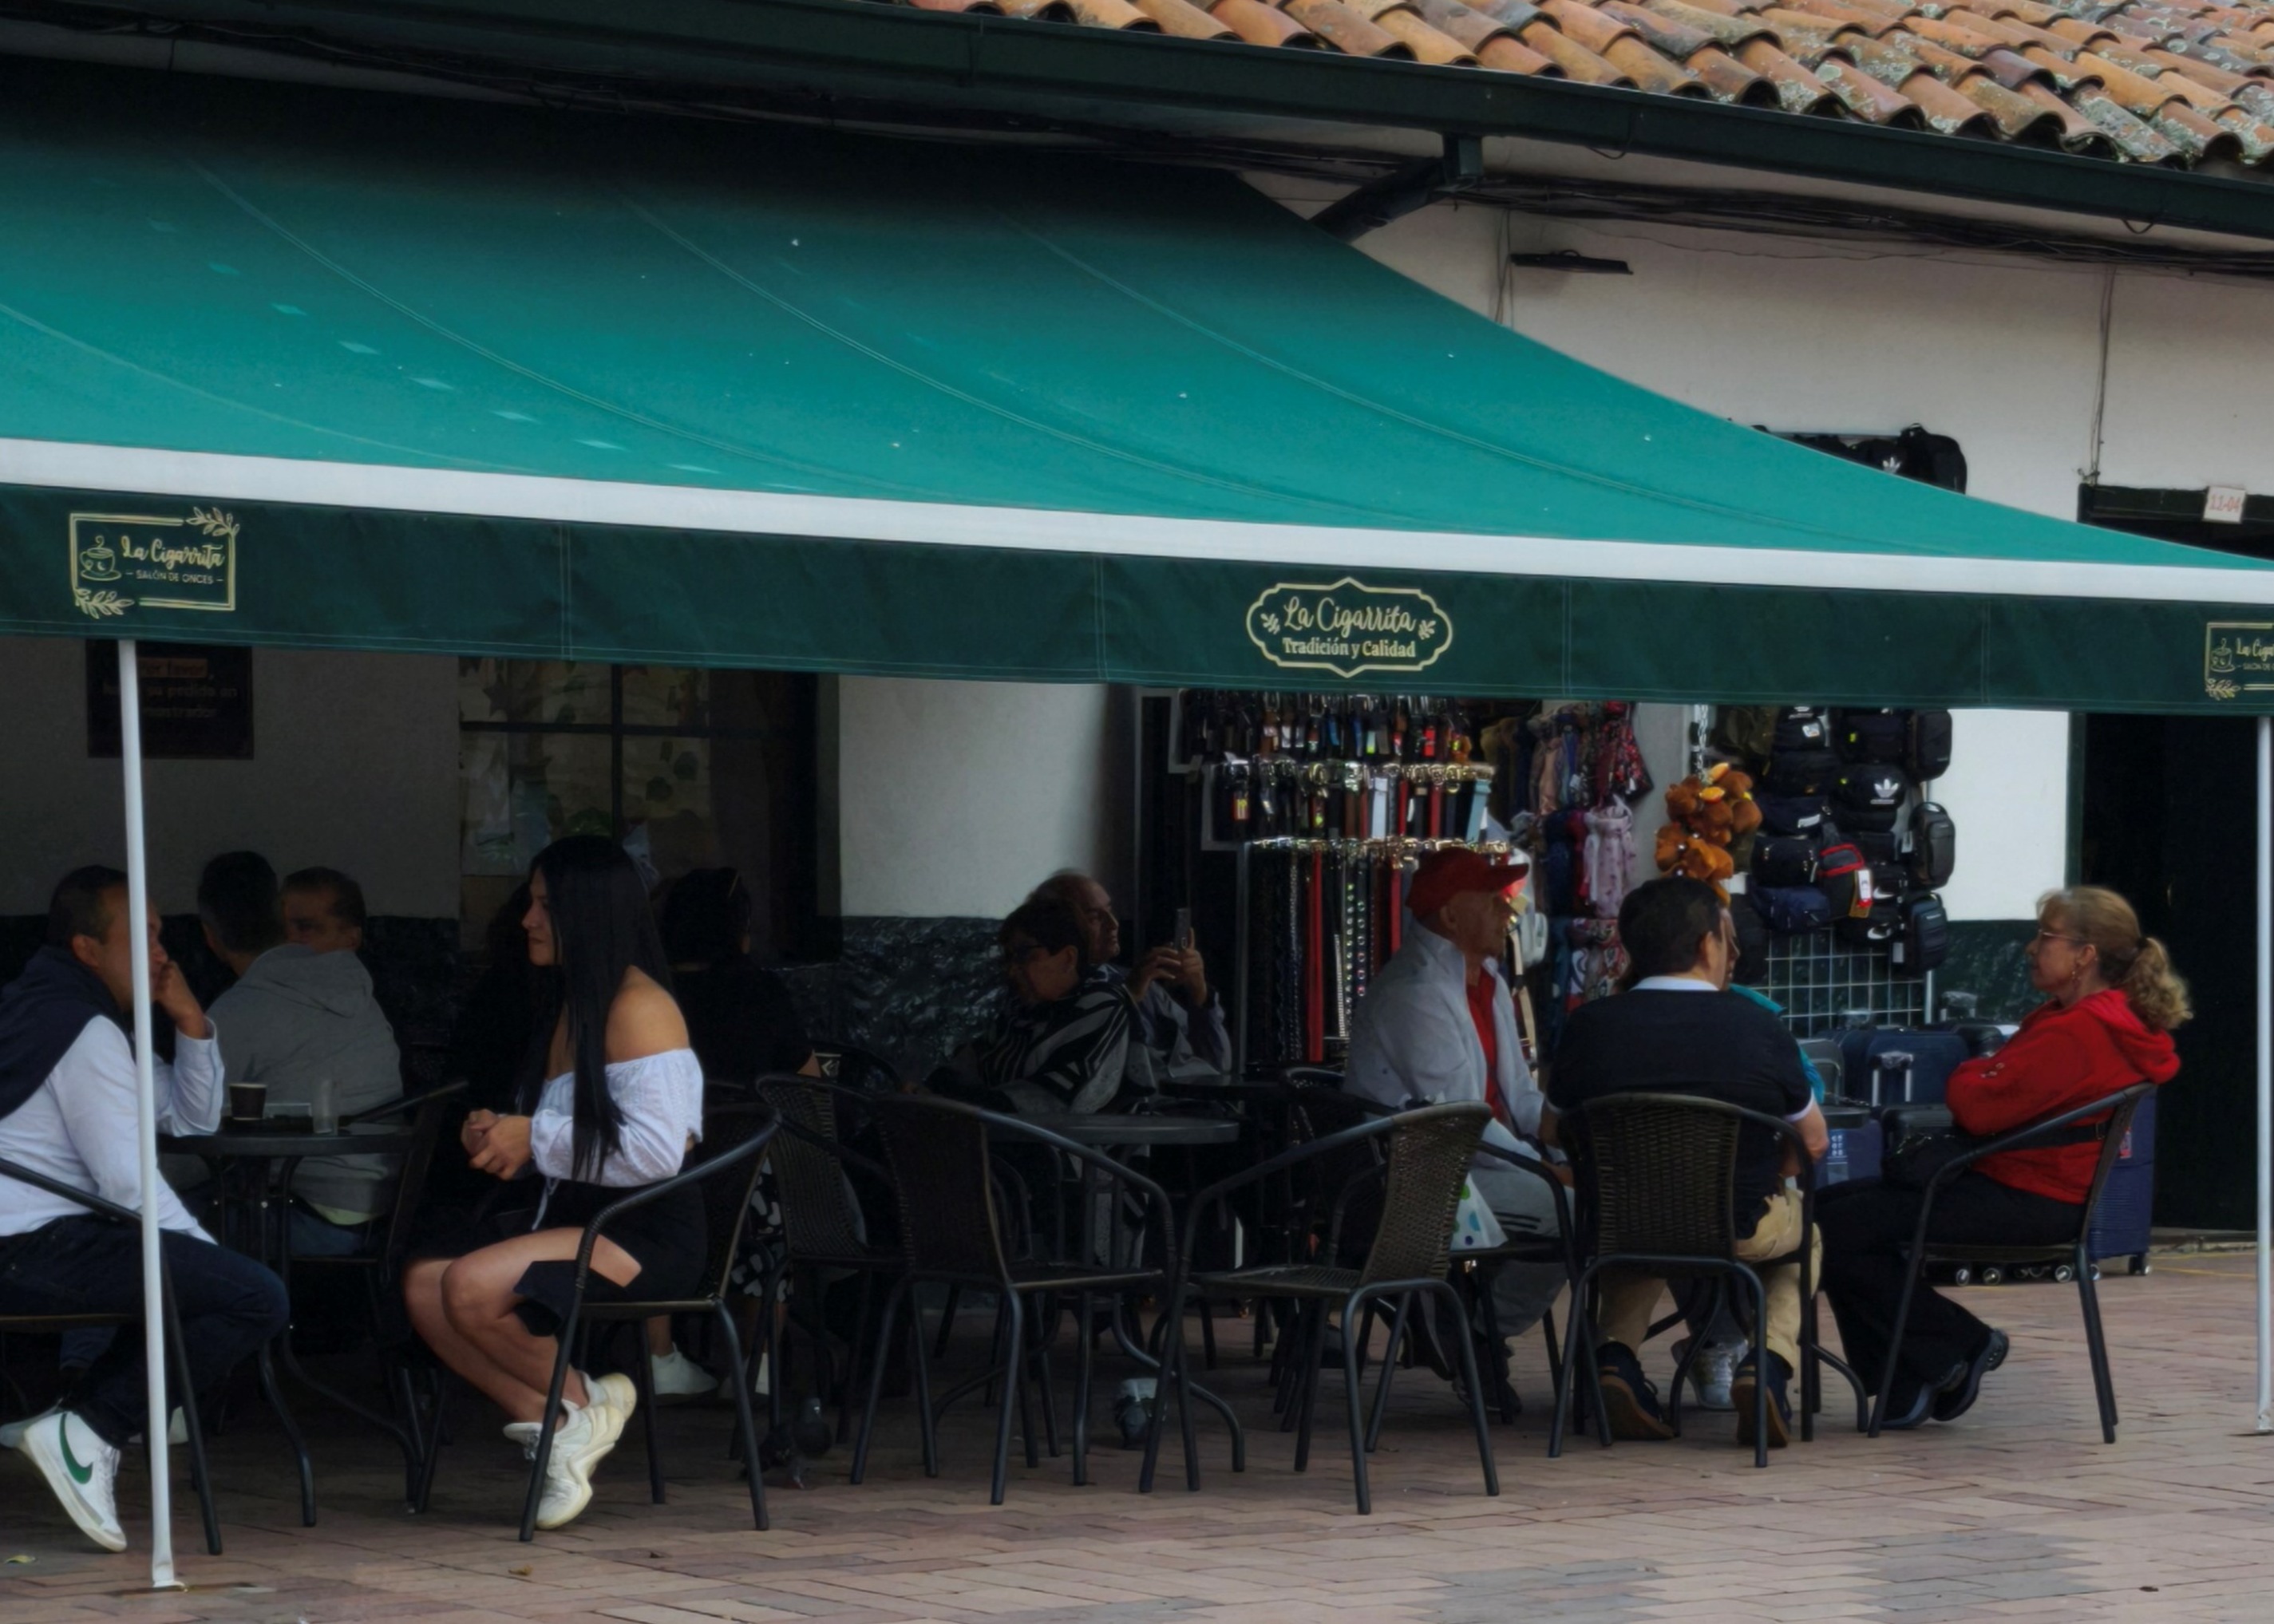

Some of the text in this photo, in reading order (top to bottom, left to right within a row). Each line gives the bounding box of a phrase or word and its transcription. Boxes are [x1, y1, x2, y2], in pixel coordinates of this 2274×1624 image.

[121, 535, 225, 570] La Cigarrita
[168, 572, 179, 582] DE
[1283, 596, 1417, 638] La Cigarrita
[1282, 637, 1416, 660] Tradición y Calidad
